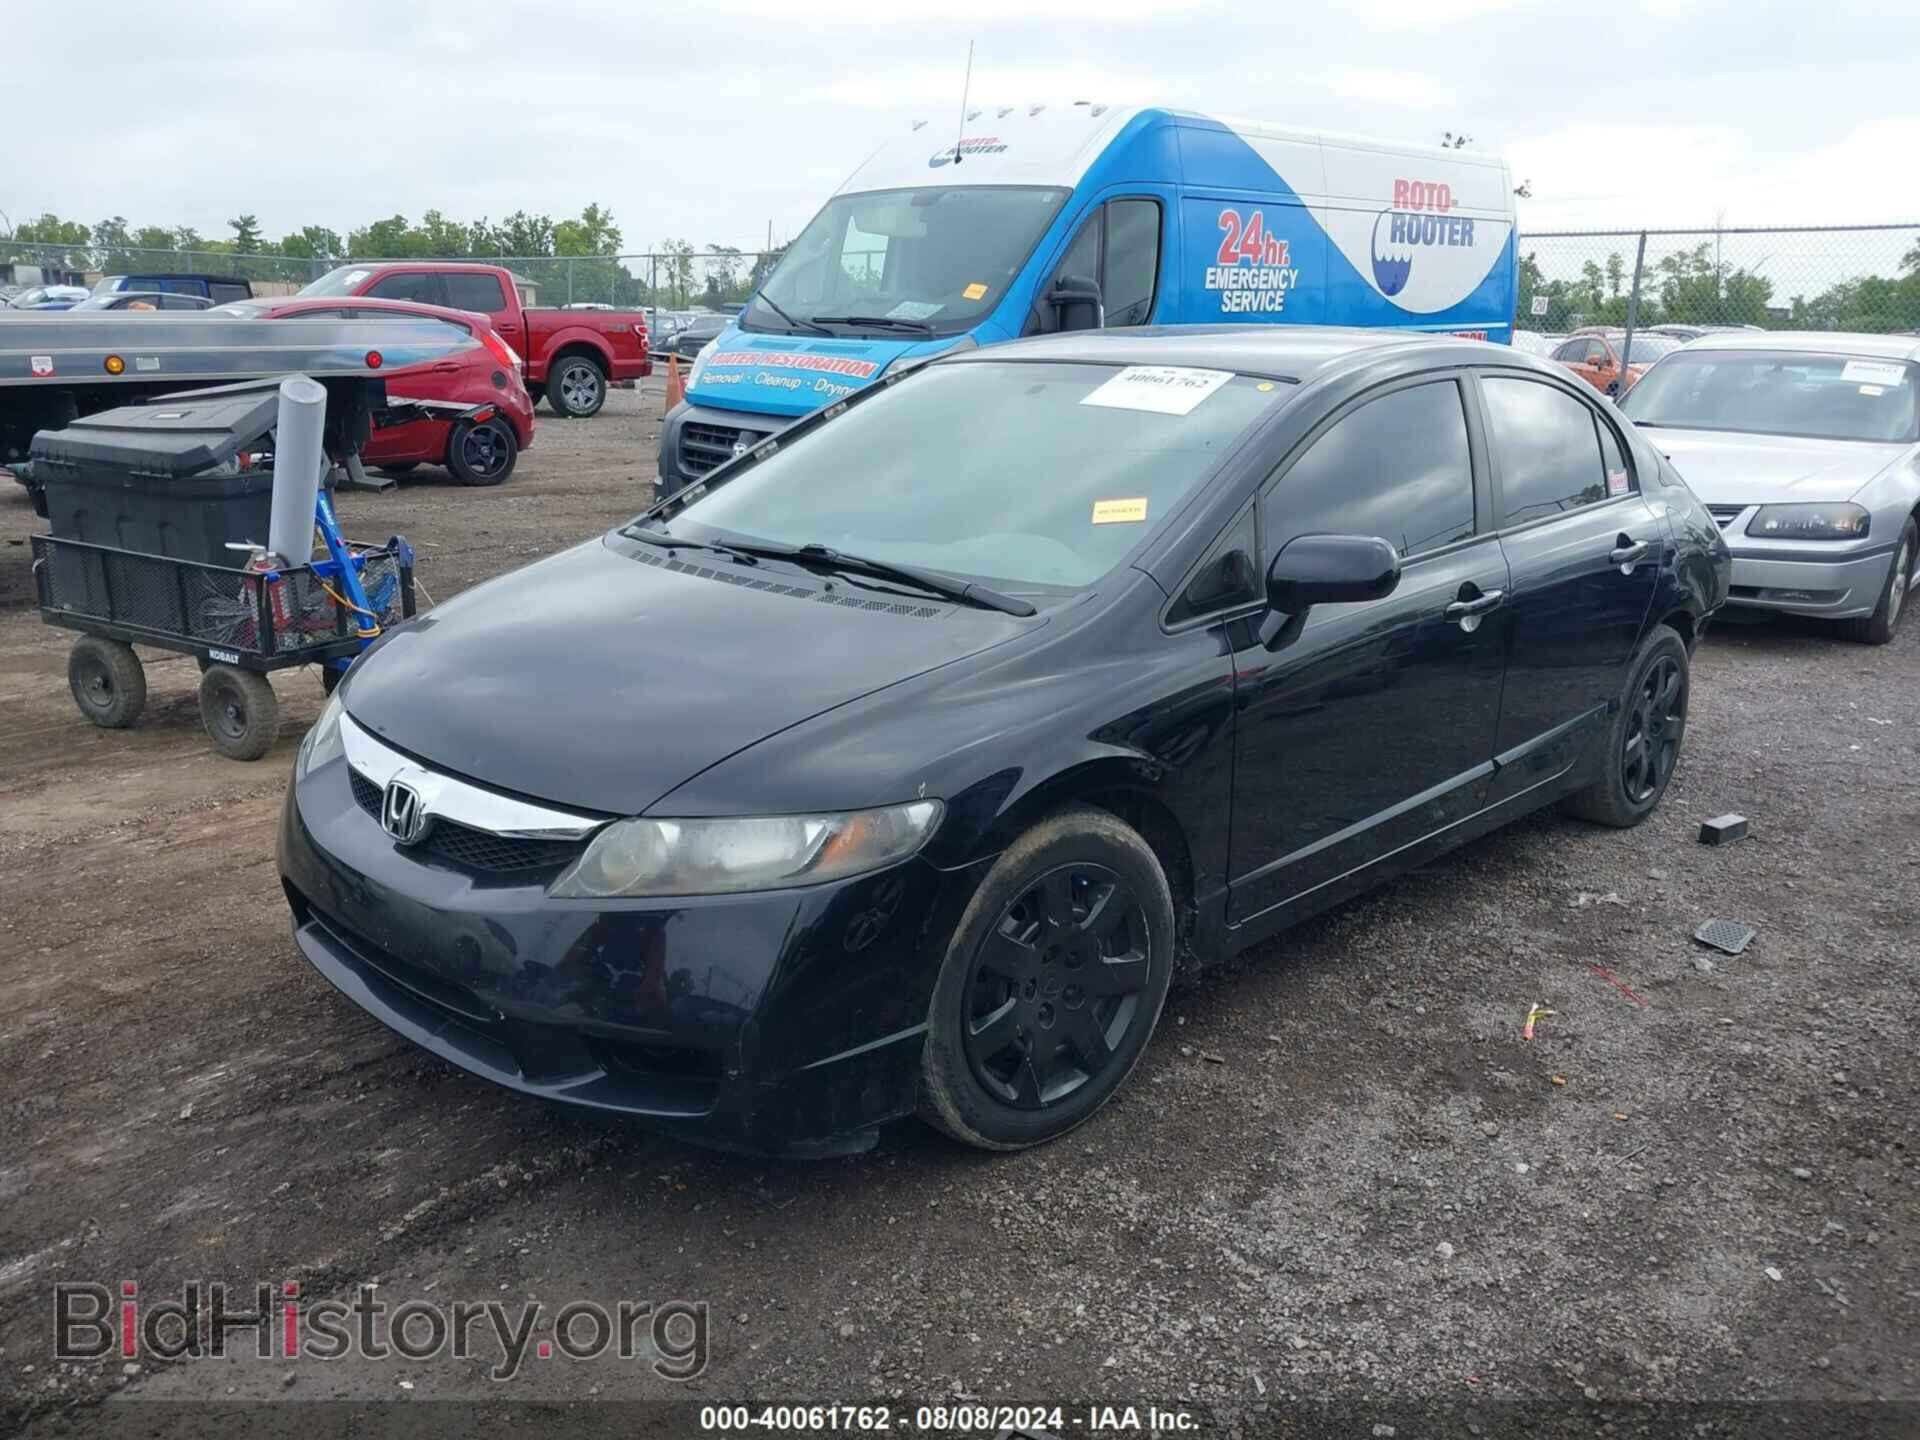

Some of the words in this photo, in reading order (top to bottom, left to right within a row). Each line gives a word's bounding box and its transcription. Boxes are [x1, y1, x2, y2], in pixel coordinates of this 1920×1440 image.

[1390, 213, 1475, 247] ROOTER
[1204, 267, 1299, 290] EMERGENCY
[1221, 290, 1285, 312] SERVICE
[763, 354, 878, 378] RESTORATION
[703, 371, 744, 384] Removal
[754, 371, 802, 391] Cleanup
[208, 649, 240, 664] KOBALT
